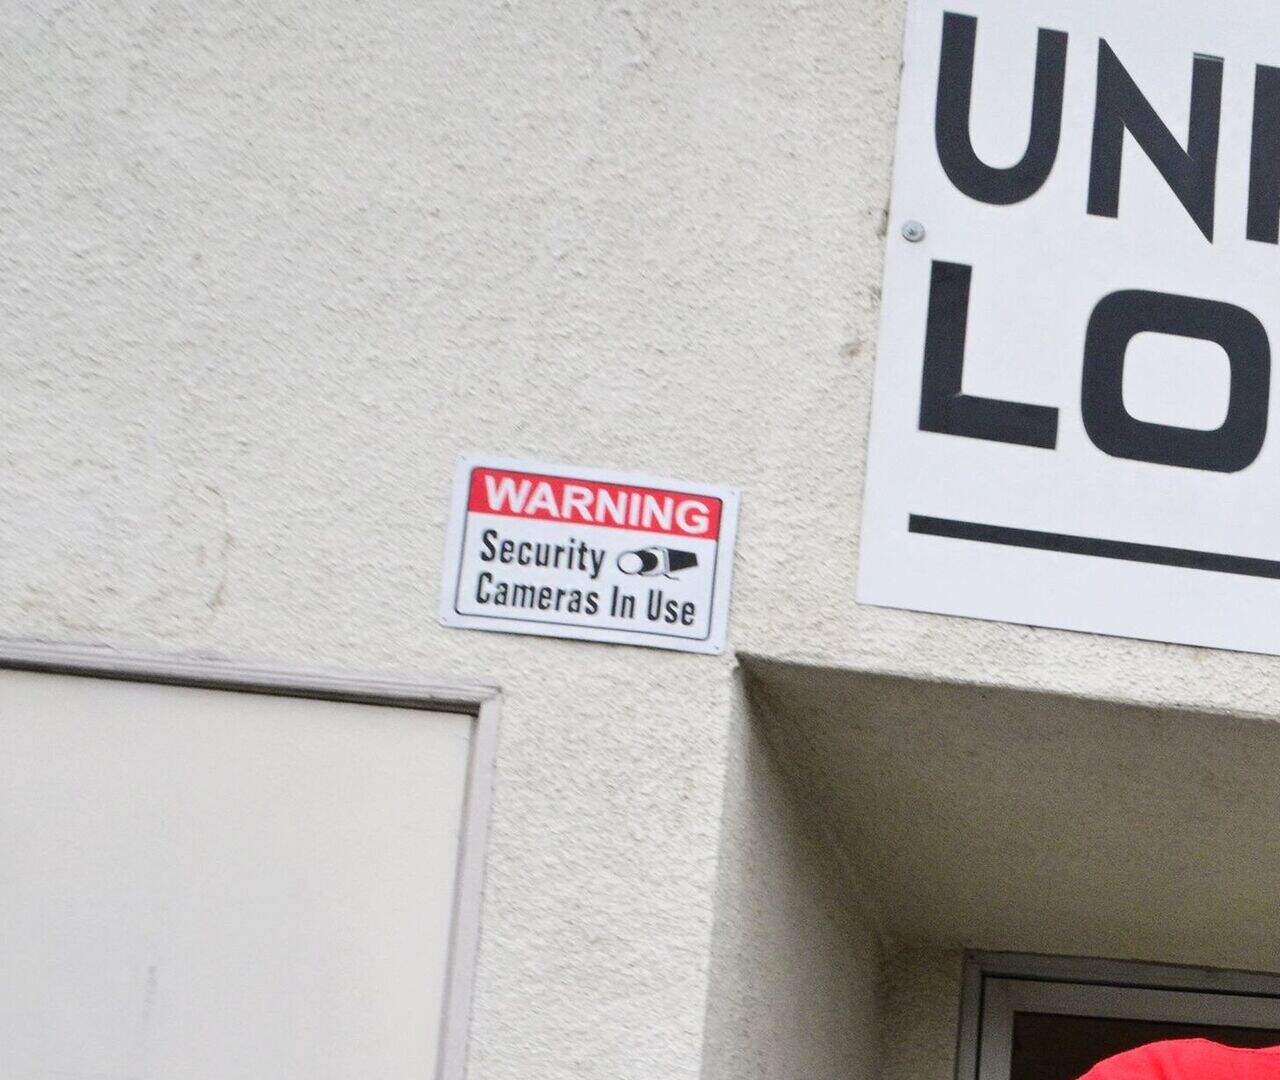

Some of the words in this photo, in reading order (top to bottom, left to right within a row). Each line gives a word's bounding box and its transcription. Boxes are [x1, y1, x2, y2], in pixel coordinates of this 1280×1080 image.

[484, 474, 710, 534] WARNING
[480, 528, 605, 579] Security
[476, 571, 599, 616] Cameras
[610, 585, 635, 618] In
[646, 590, 696, 626] Use
